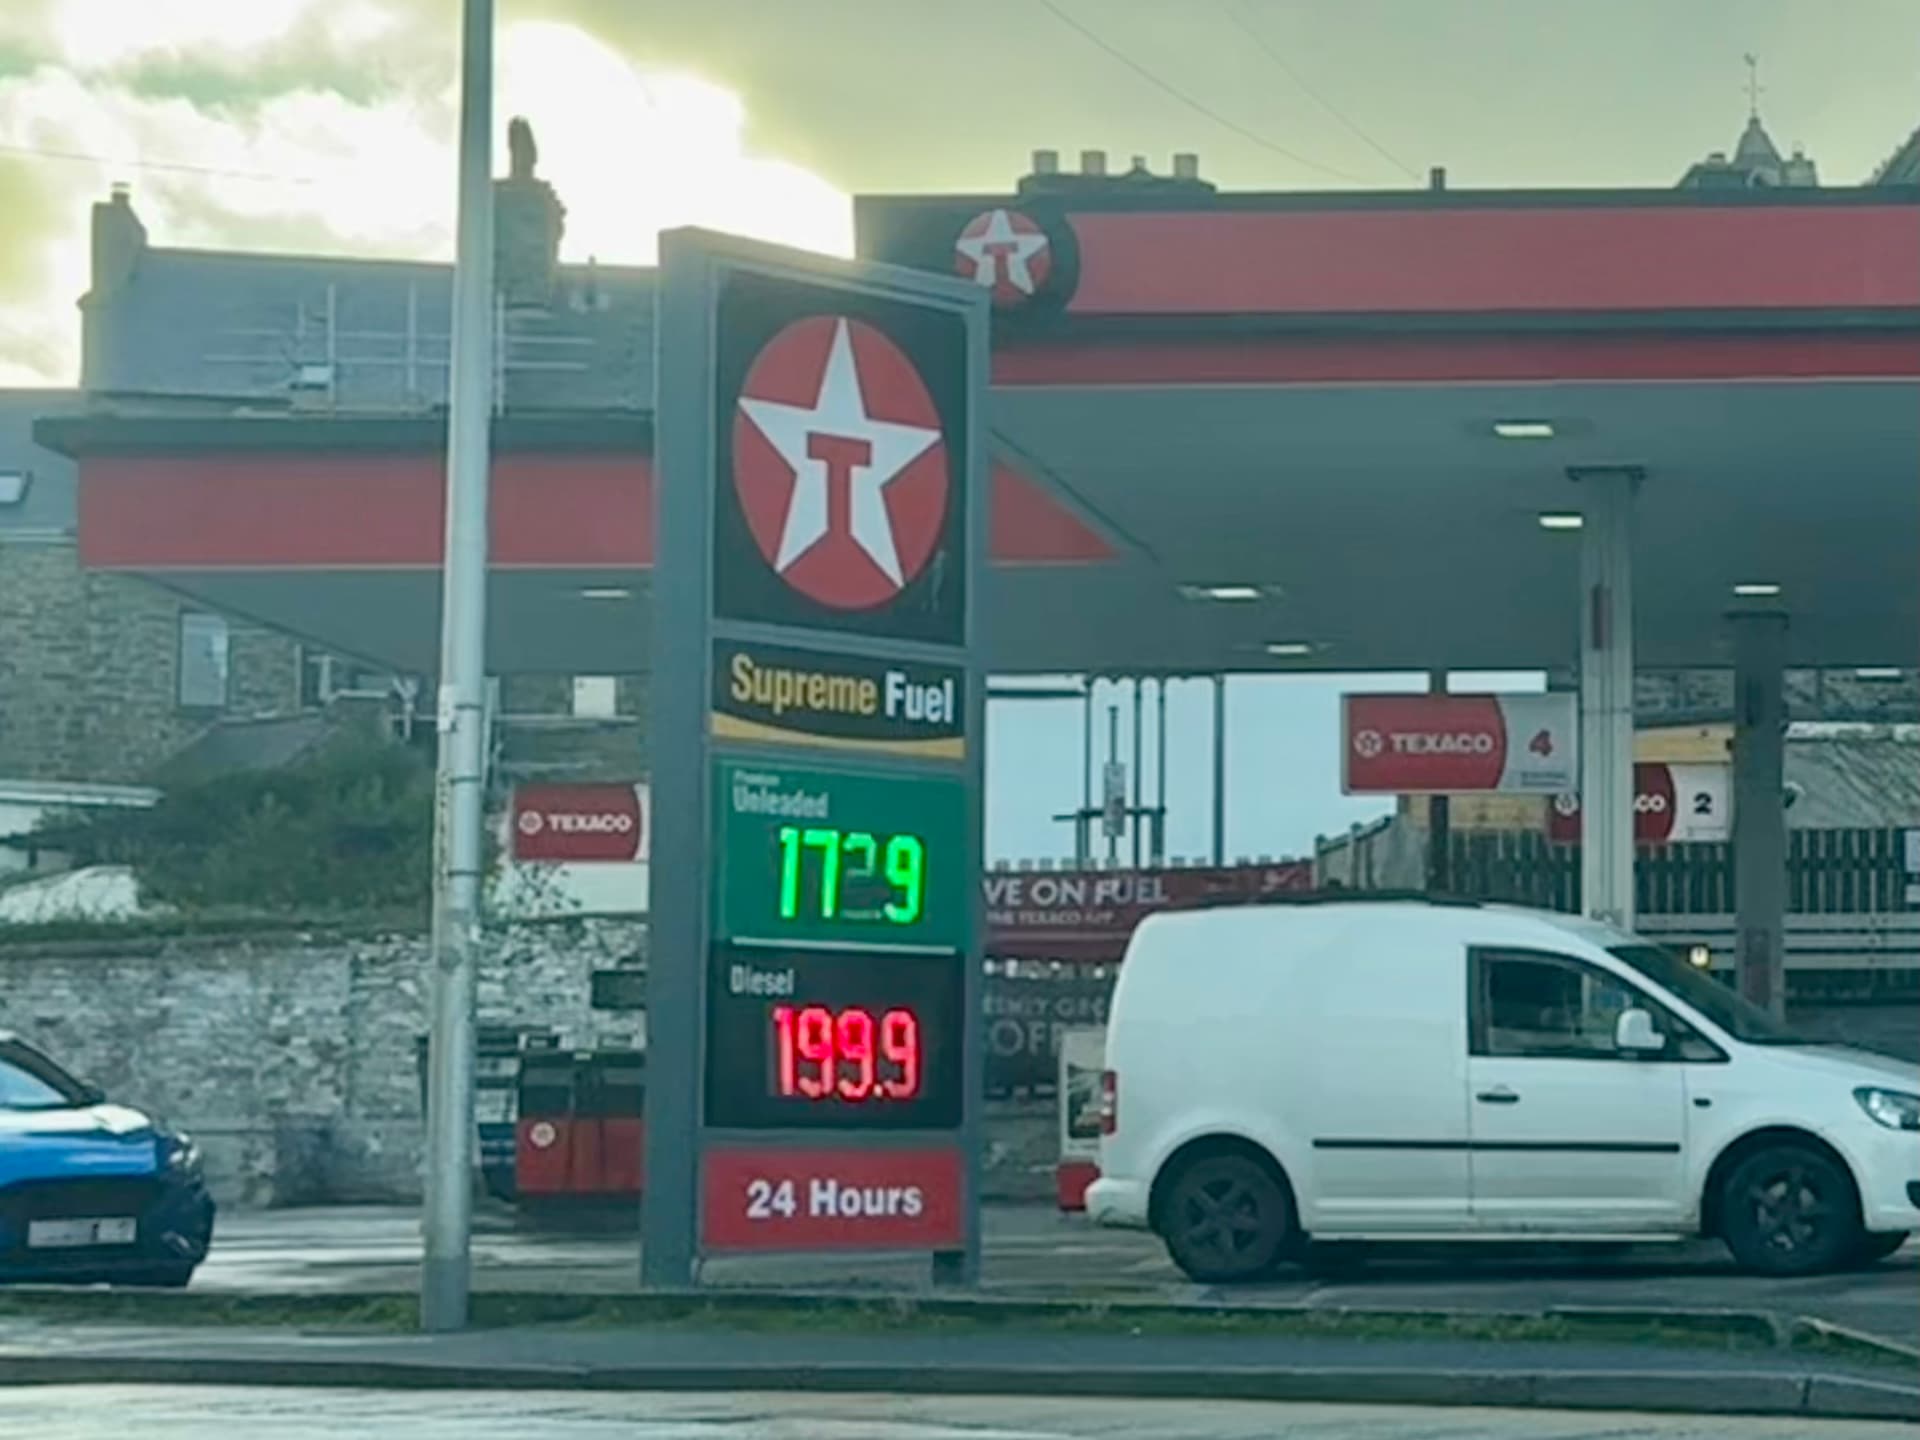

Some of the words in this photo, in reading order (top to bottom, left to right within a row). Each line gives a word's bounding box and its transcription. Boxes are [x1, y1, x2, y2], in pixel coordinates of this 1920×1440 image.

[732, 654, 877, 714] Supreme
[886, 672, 953, 722] Fuel
[1390, 732, 1494, 754] TEXACO
[1529, 730, 1553, 756] 4
[733, 785, 829, 818] Unleaded
[1693, 793, 1713, 814] 2
[547, 813, 632, 832] TEXACO
[1032, 878, 1085, 905] ON
[1094, 878, 1169, 904] FUEL
[730, 965, 794, 995] Diesel
[773, 1006, 917, 1099] 199.9
[747, 1180, 795, 1217] 24
[808, 1180, 922, 1216] Hours
